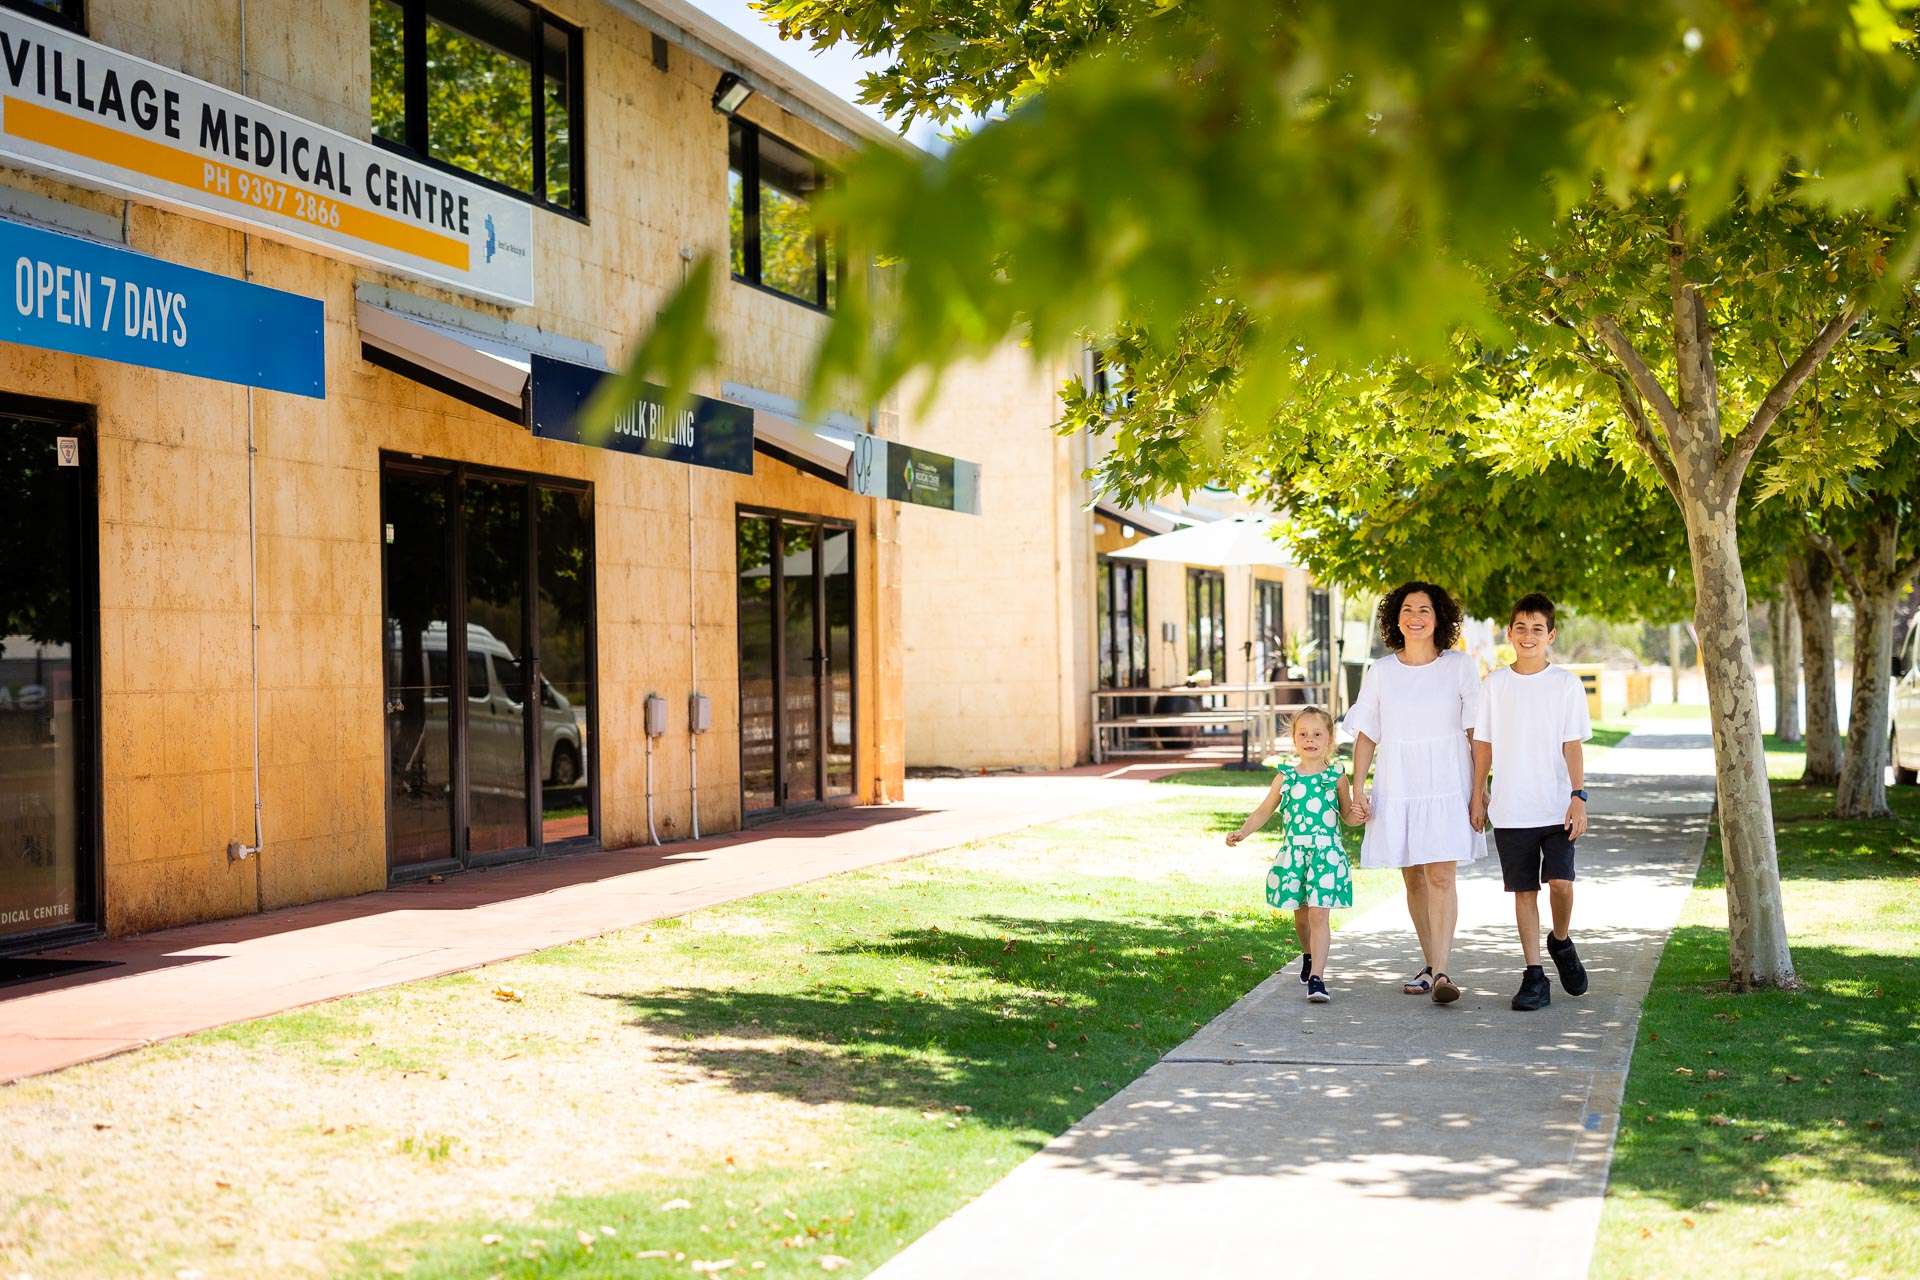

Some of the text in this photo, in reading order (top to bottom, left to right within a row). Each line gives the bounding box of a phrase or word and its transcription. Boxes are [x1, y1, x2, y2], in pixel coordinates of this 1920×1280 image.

[0, 31, 469, 235] VILLAGE MEDICAL CENTRE
[204, 162, 341, 228] PH 9397 2866
[16, 256, 187, 347] OPEN 7 DAYS
[649, 402, 695, 448] BILLING
[33, 903, 70, 919] CENTRE
